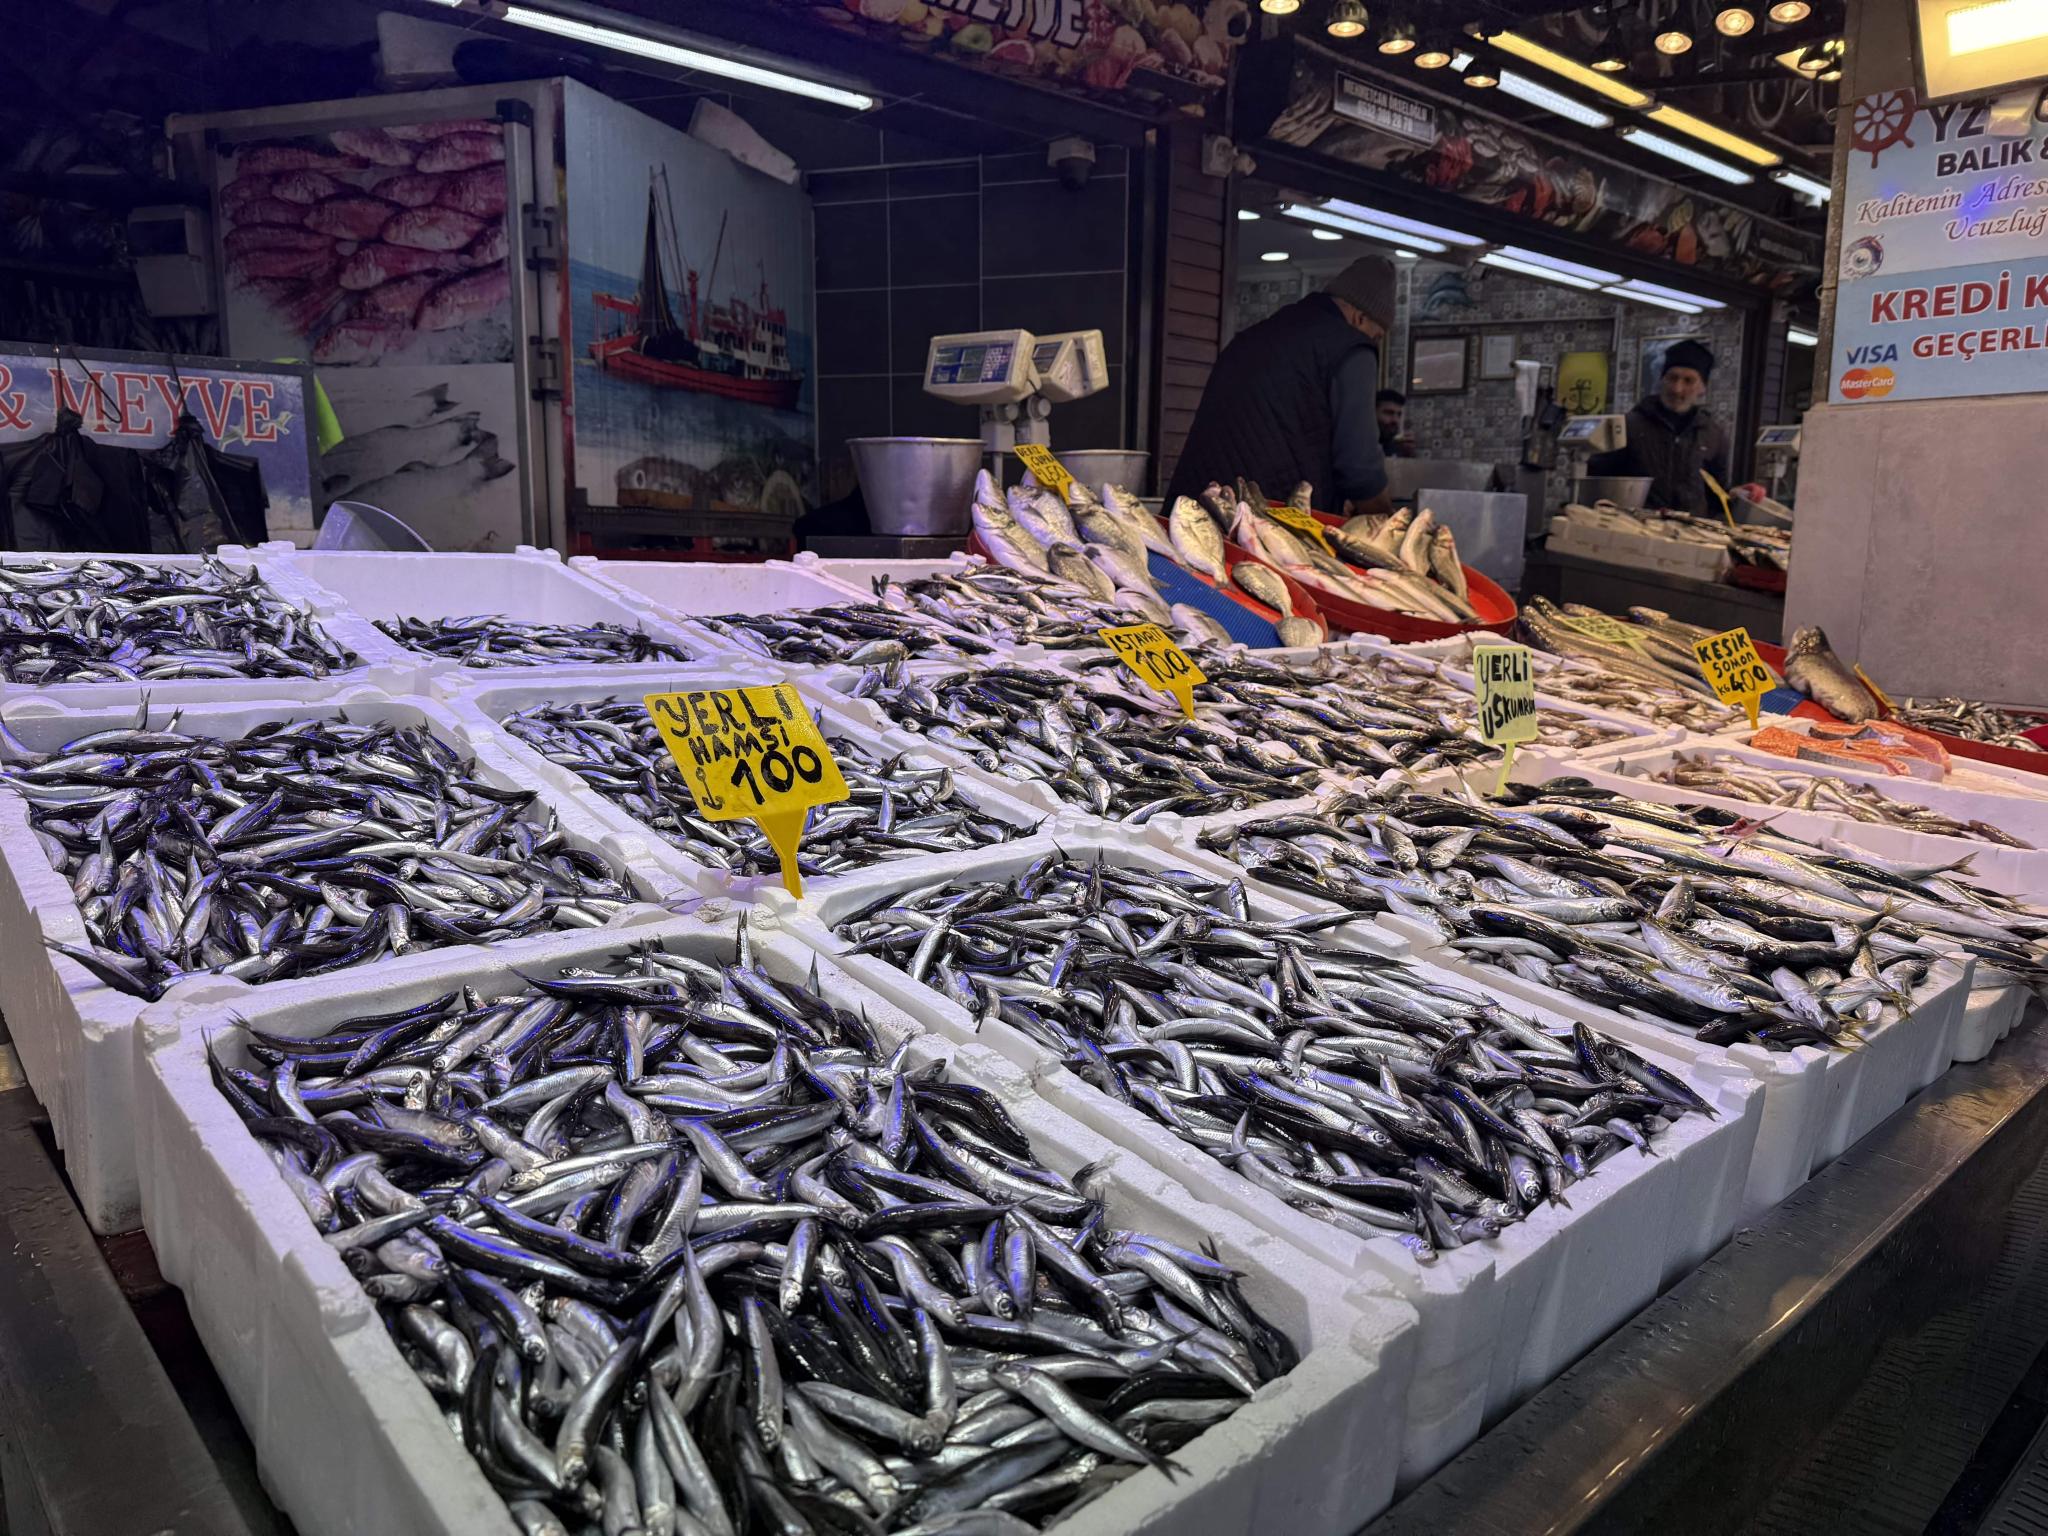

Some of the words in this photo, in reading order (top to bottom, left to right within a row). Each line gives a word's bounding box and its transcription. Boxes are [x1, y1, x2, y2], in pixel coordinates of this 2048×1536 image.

[1936, 139, 2033, 177] BALIK
[1857, 188, 1963, 223] Kalitenin
[1971, 175, 2048, 208] Adres
[1871, 270, 2010, 323] KREDİ
[1846, 343, 1898, 365] VISA
[1841, 376, 1895, 390] MasterCard
[48, 368, 278, 442] MEYVE
[1135, 649, 1190, 683] 100
[1729, 665, 1767, 693] 400
[731, 745, 822, 805] 100
